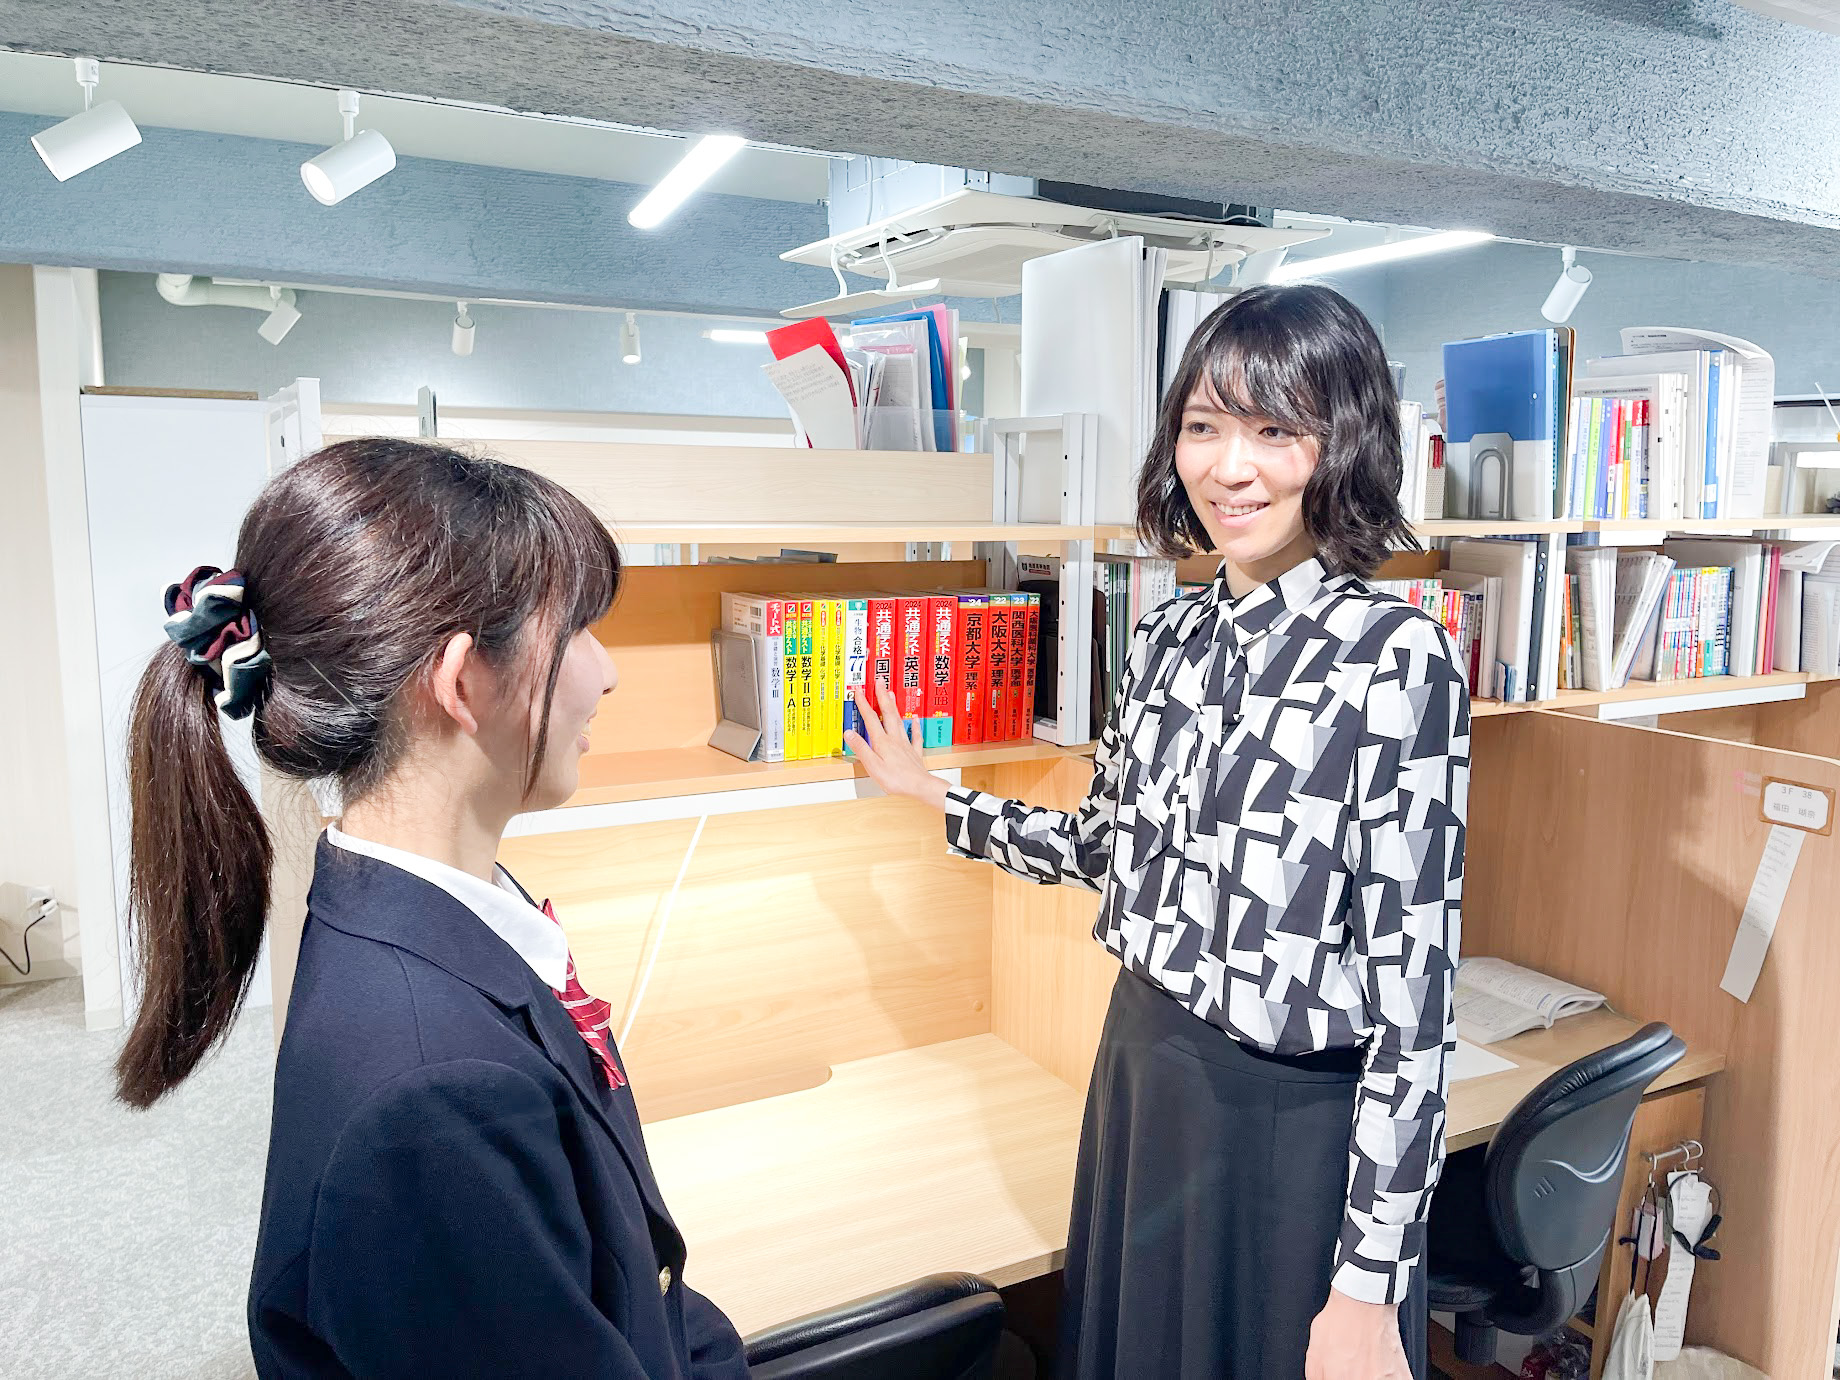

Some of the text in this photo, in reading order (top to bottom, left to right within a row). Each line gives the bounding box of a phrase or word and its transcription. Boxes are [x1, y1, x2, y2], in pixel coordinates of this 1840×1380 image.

[769, 602, 781, 635] チャート式
[876, 602, 892, 610] 2024
[905, 600, 921, 608] 2024
[936, 600, 952, 608] 2024
[876, 609, 892, 658] 共通テスト
[905, 607, 921, 656] 共通テスト
[935, 606, 952, 687] 共通テスト 数学
[965, 613, 982, 690] 京都大学 理系
[991, 611, 1008, 687] 大阪大学 理系
[1010, 610, 1025, 667] 関西医科大学
[904, 656, 919, 688] 英語
